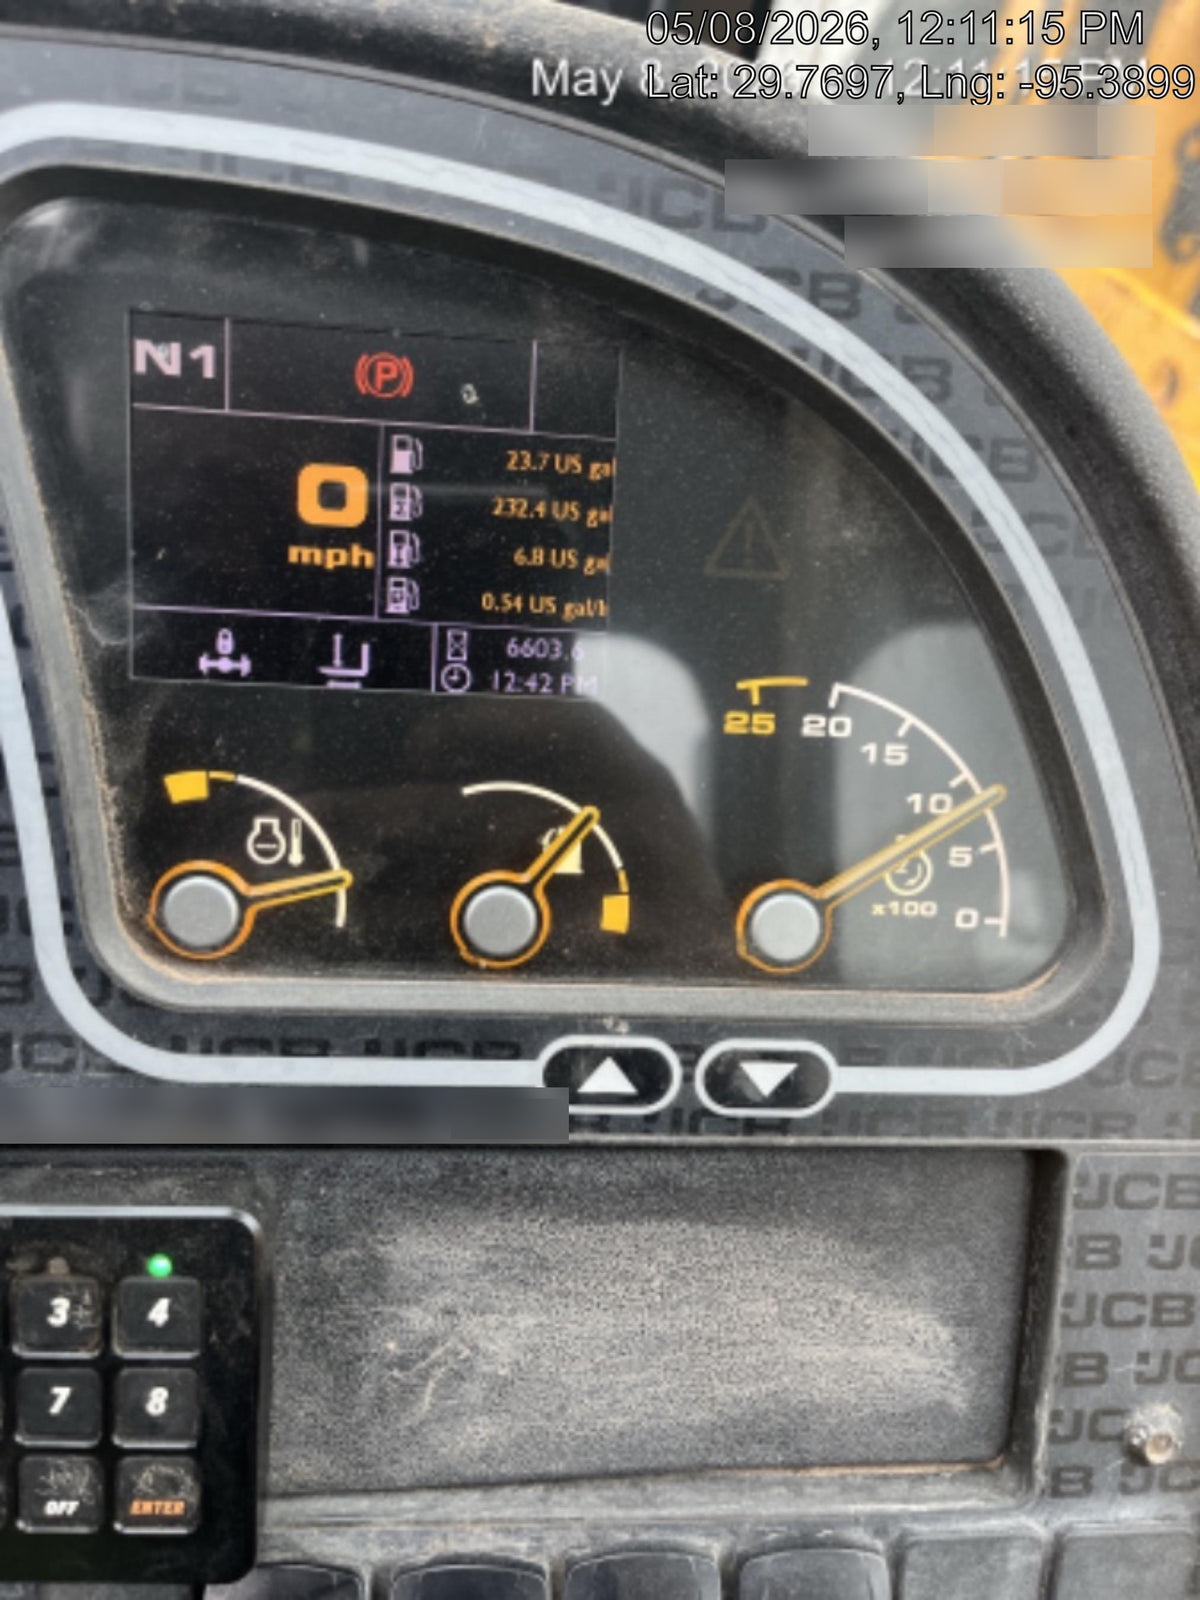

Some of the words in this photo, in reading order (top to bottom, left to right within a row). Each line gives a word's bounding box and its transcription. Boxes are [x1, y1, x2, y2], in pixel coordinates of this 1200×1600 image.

[134, 338, 215, 379] N1
[506, 450, 551, 471] 23.7
[553, 453, 582, 474] US
[298, 463, 368, 528] 0
[492, 495, 547, 519] 232.4
[552, 500, 580, 520] US
[288, 543, 375, 570] mph
[513, 546, 545, 567] 6.8
[550, 548, 578, 569] US
[481, 592, 522, 613] 0.54
[529, 594, 556, 614] US
[491, 670, 553, 693] 12:42
[723, 711, 776, 735] 25
[802, 715, 852, 738] 20
[860, 743, 909, 766] 15
[906, 793, 953, 815] 10
[948, 846, 973, 868] 5
[871, 900, 938, 917] x100
[955, 907, 979, 930] 0
[46, 1297, 71, 1327] 3
[146, 1297, 170, 1327] 4
[1060, 1292, 1195, 1329] JCB
[48, 1386, 72, 1416] 7
[144, 1386, 169, 1417] 8
[1049, 1408, 1130, 1445] JC
[44, 1500, 80, 1516] OFF
[129, 1500, 186, 1516] ENTER
